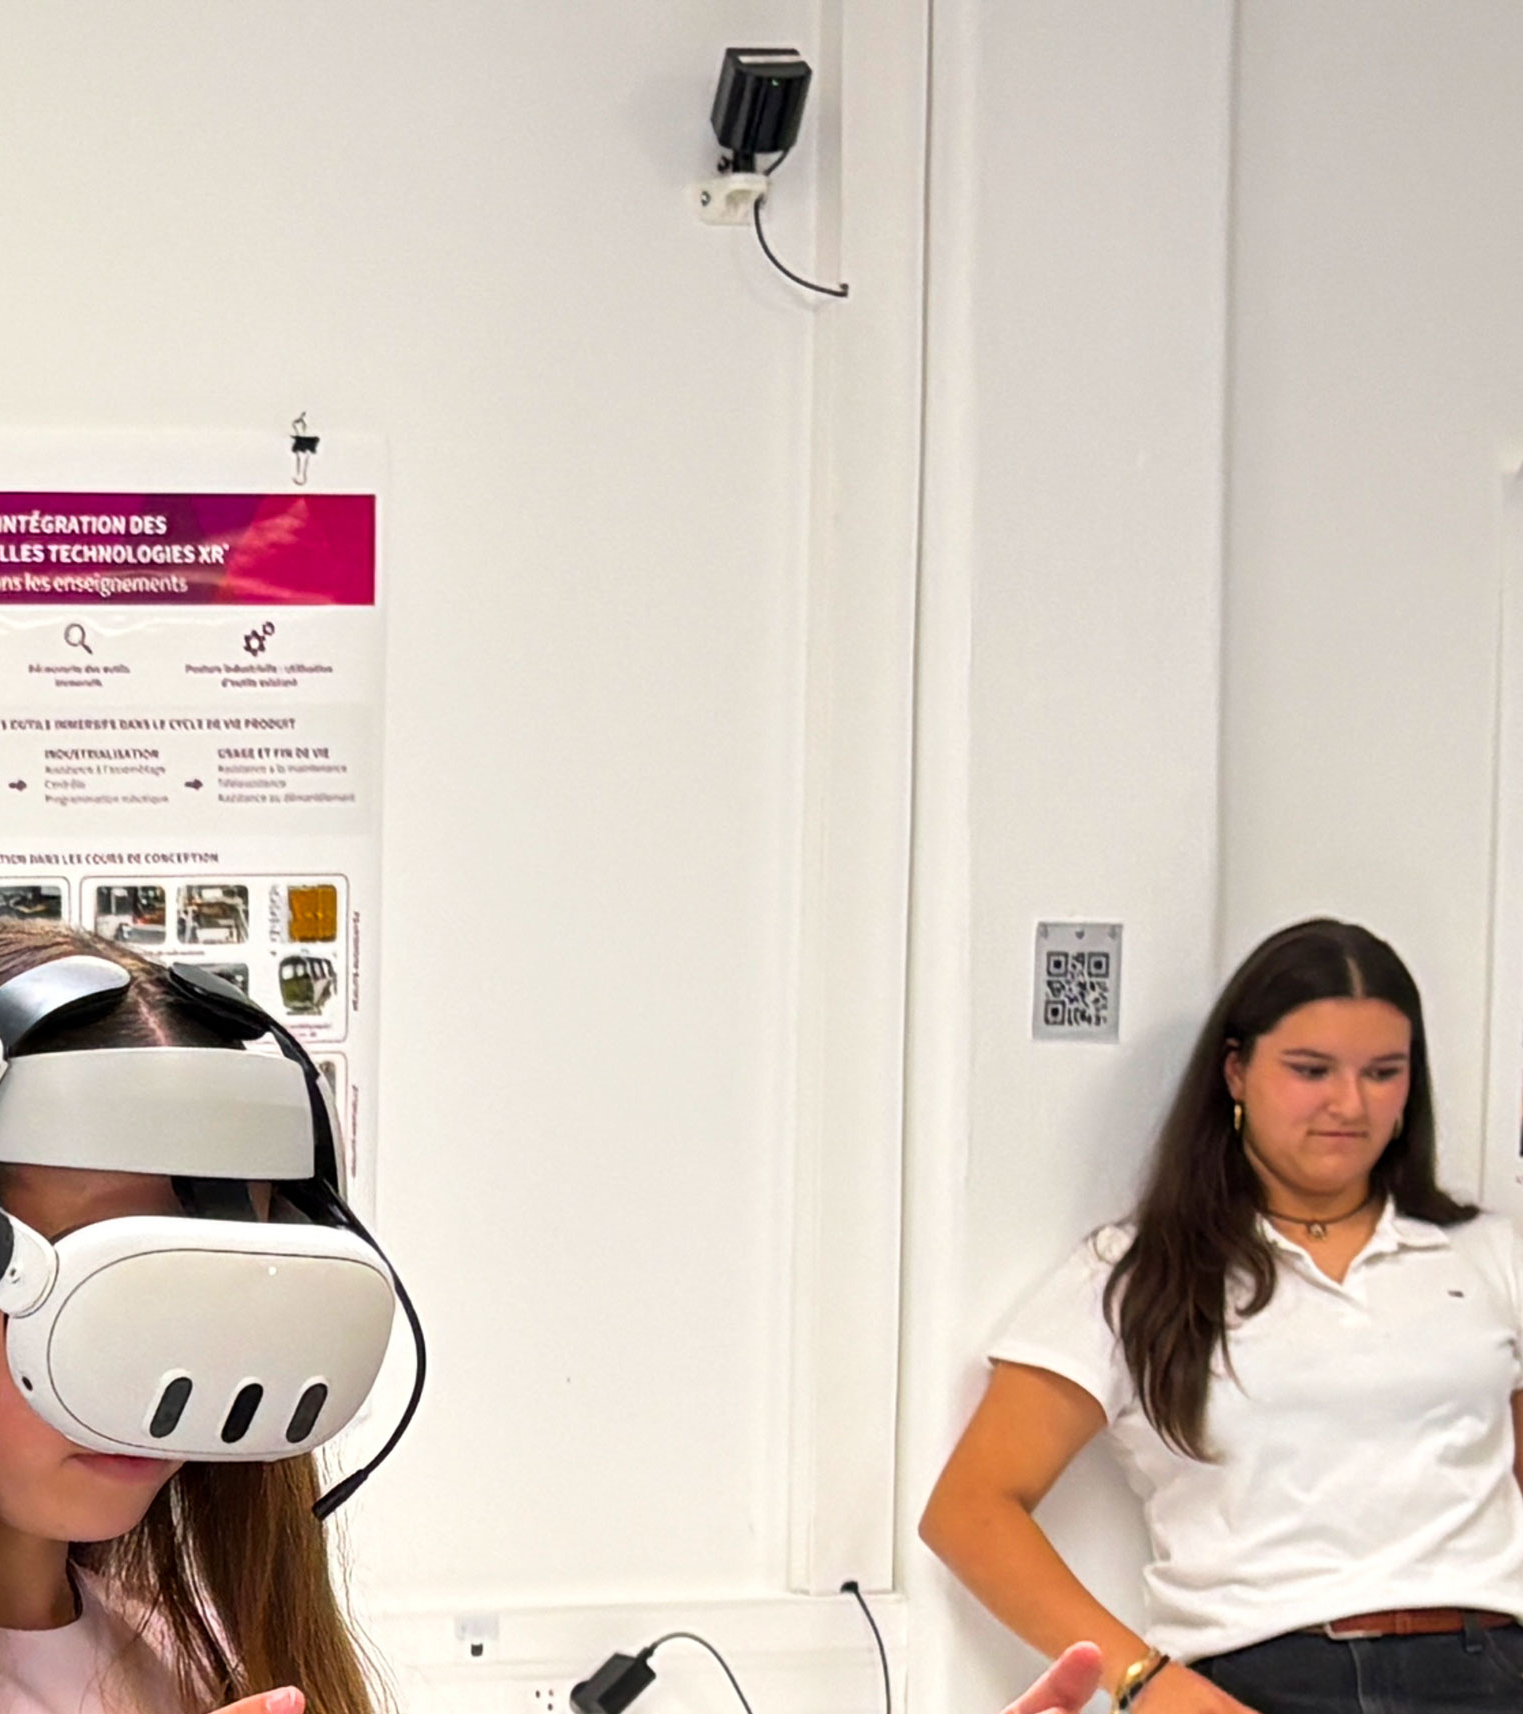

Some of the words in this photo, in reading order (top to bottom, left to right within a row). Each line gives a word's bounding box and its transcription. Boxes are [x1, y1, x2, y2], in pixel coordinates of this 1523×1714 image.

[129, 515, 167, 535] DES
[47, 544, 196, 564] TECHNOLOGIES
[25, 573, 51, 593] les
[53, 573, 188, 598] enseignements
